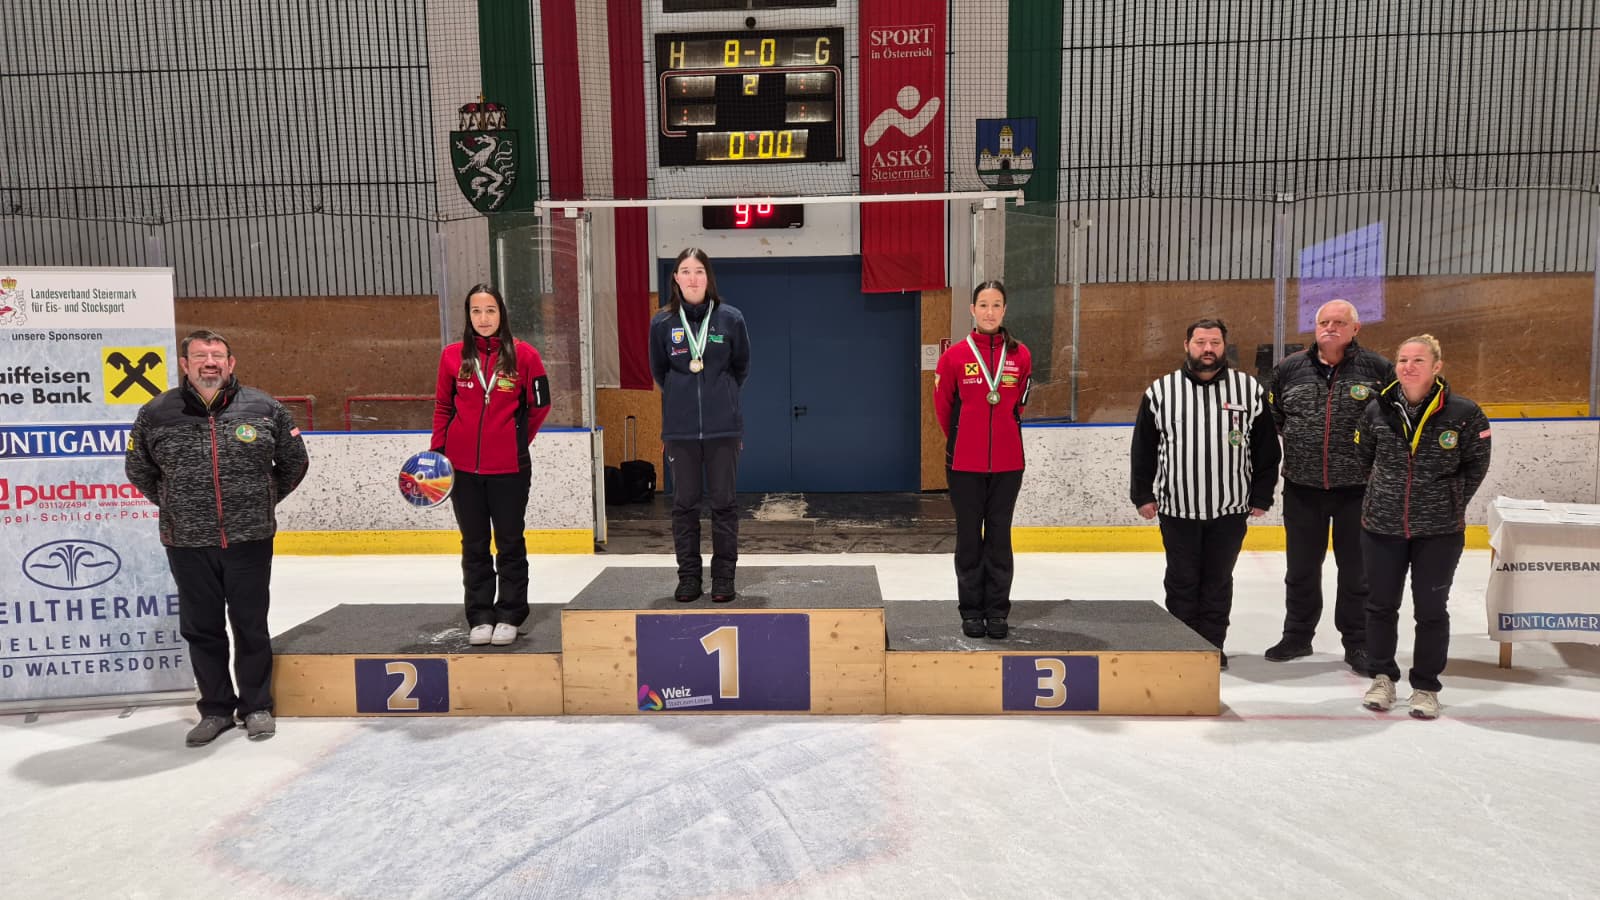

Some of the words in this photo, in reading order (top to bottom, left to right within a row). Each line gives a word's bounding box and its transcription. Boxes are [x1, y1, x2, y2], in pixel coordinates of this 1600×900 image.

[870, 27, 933, 46] SPORT
[669, 41, 685, 69] H
[815, 37, 831, 65] G
[871, 50, 880, 59] in
[883, 48, 932, 58] Österreich
[744, 76, 756, 95] 2
[871, 145, 931, 168] ASKÖ
[871, 167, 931, 181] Steiermark
[30, 288, 90, 300] Landesverband
[93, 288, 137, 299] Steiermark
[31, 302, 43, 313] für
[45, 303, 61, 313] Eis-
[65, 302, 79, 312] und
[81, 301, 125, 314] Stocksport
[11, 332, 46, 341] unsere
[48, 331, 103, 342] Sponsoren
[32, 386, 92, 405] Bank
[1502, 615, 1598, 630] PUNTIGAMER
[0, 630, 182, 652] ELLENHOTEL
[25, 655, 183, 678] WALTERSDORF
[700, 626, 740, 699] 1
[385, 661, 420, 710] 2
[661, 685, 692, 699] Weiz
[1034, 657, 1067, 709] 3
